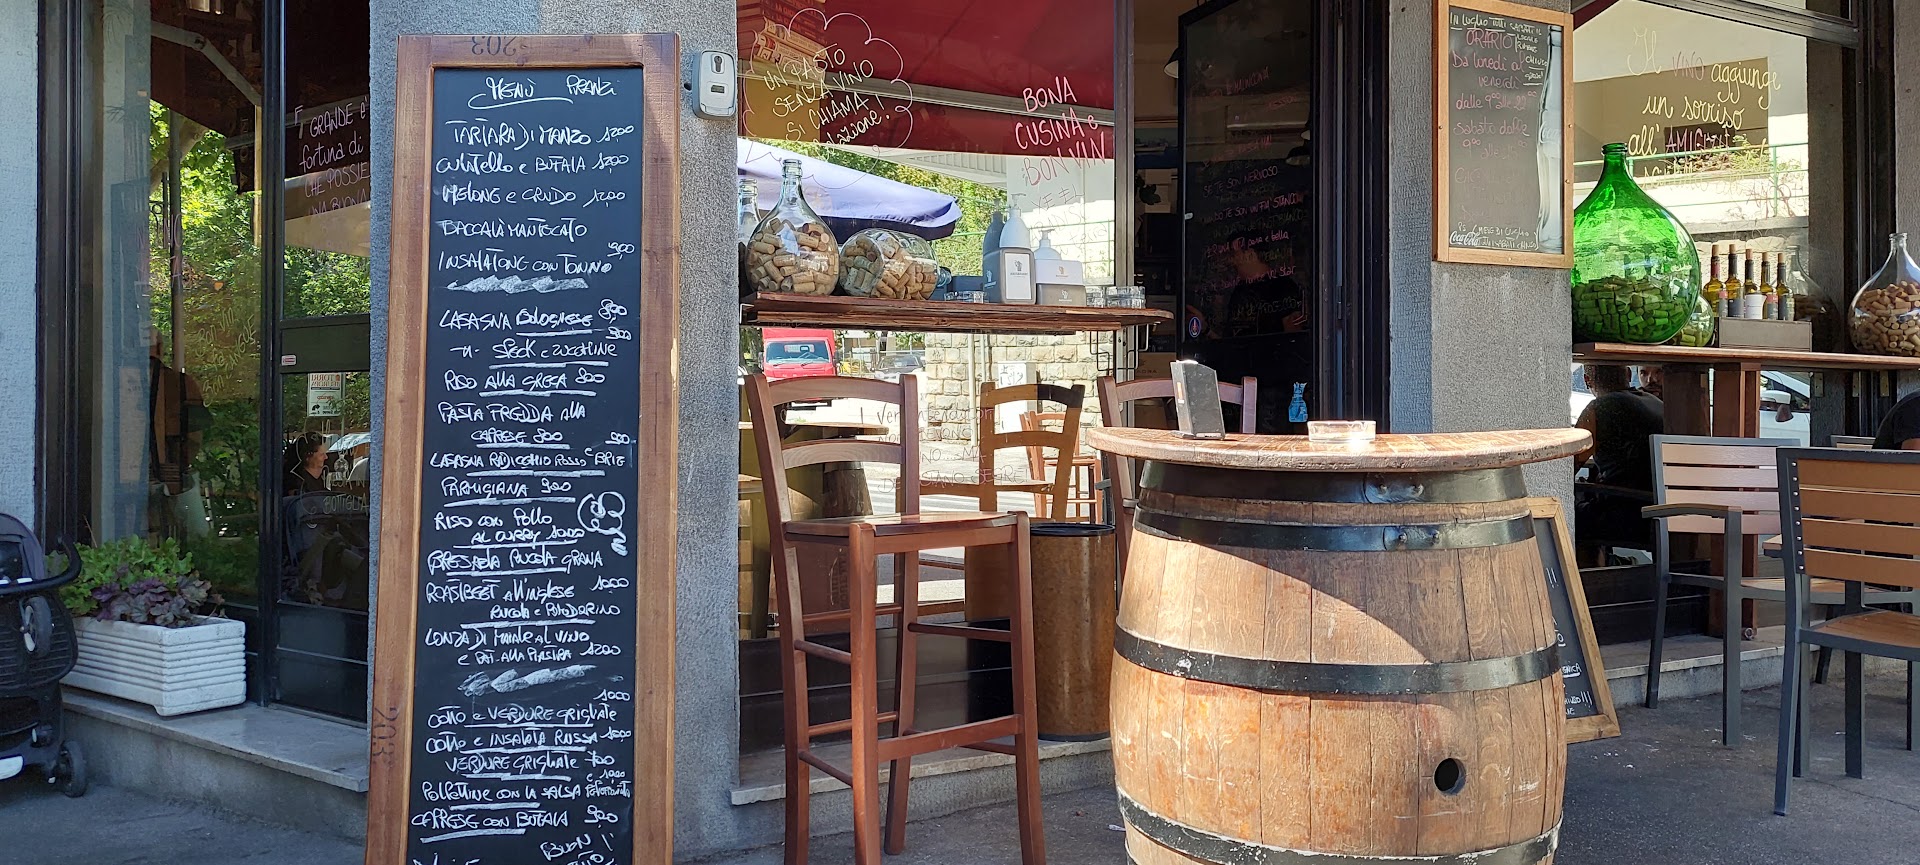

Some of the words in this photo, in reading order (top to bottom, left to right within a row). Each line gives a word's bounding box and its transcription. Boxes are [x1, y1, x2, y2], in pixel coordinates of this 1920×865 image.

[1450, 12, 1459, 25] IN
[1465, 29, 1513, 50] ORARIO
[764, 62, 789, 91] UN
[783, 43, 846, 82] PASTO
[1452, 50, 1469, 68] Da
[1473, 52, 1507, 72] lunedì
[772, 78, 834, 118] SENZA
[832, 59, 874, 92] VINO
[1478, 76, 1522, 89] venerdì
[1672, 50, 1705, 81] VINO
[1710, 61, 1781, 111] aggiunge
[1022, 76, 1078, 112] BONA
[1455, 93, 1484, 110] dalle
[309, 102, 354, 138] GRANDE
[785, 121, 807, 142] SI
[808, 91, 870, 130] CHIAMA
[1641, 93, 1674, 119] un
[1681, 95, 1745, 131] sorriso
[445, 117, 516, 147] TARTARA
[533, 126, 592, 146] MANZO
[1015, 106, 1085, 150] CUSINA
[299, 142, 346, 173] fortuna
[348, 130, 365, 156] di
[1627, 123, 1660, 157] all'
[1023, 147, 1070, 186] BON
[1068, 131, 1106, 170] VIN
[442, 182, 501, 205] MELONE
[521, 187, 577, 206] CRUDO
[439, 309, 513, 331] LASAGNA
[444, 369, 478, 392] RISO
[521, 372, 568, 392] GRECA
[437, 401, 485, 424] PASTA
[486, 401, 554, 423] FREDDA
[876, 402, 901, 425] Ver
[429, 452, 485, 470] LASAGNA
[441, 476, 530, 498] PARMIGIANA
[434, 511, 473, 531] RISO
[471, 532, 491, 544] AL
[495, 530, 541, 544] CURRY
[425, 628, 470, 647] LONZA
[554, 632, 590, 644] VINO
[487, 704, 555, 724] VERDURE
[554, 729, 598, 745] RUSSA
[444, 753, 511, 772] VERDURE
[540, 783, 582, 800] SALSA
[411, 807, 480, 830] CAPRESE
